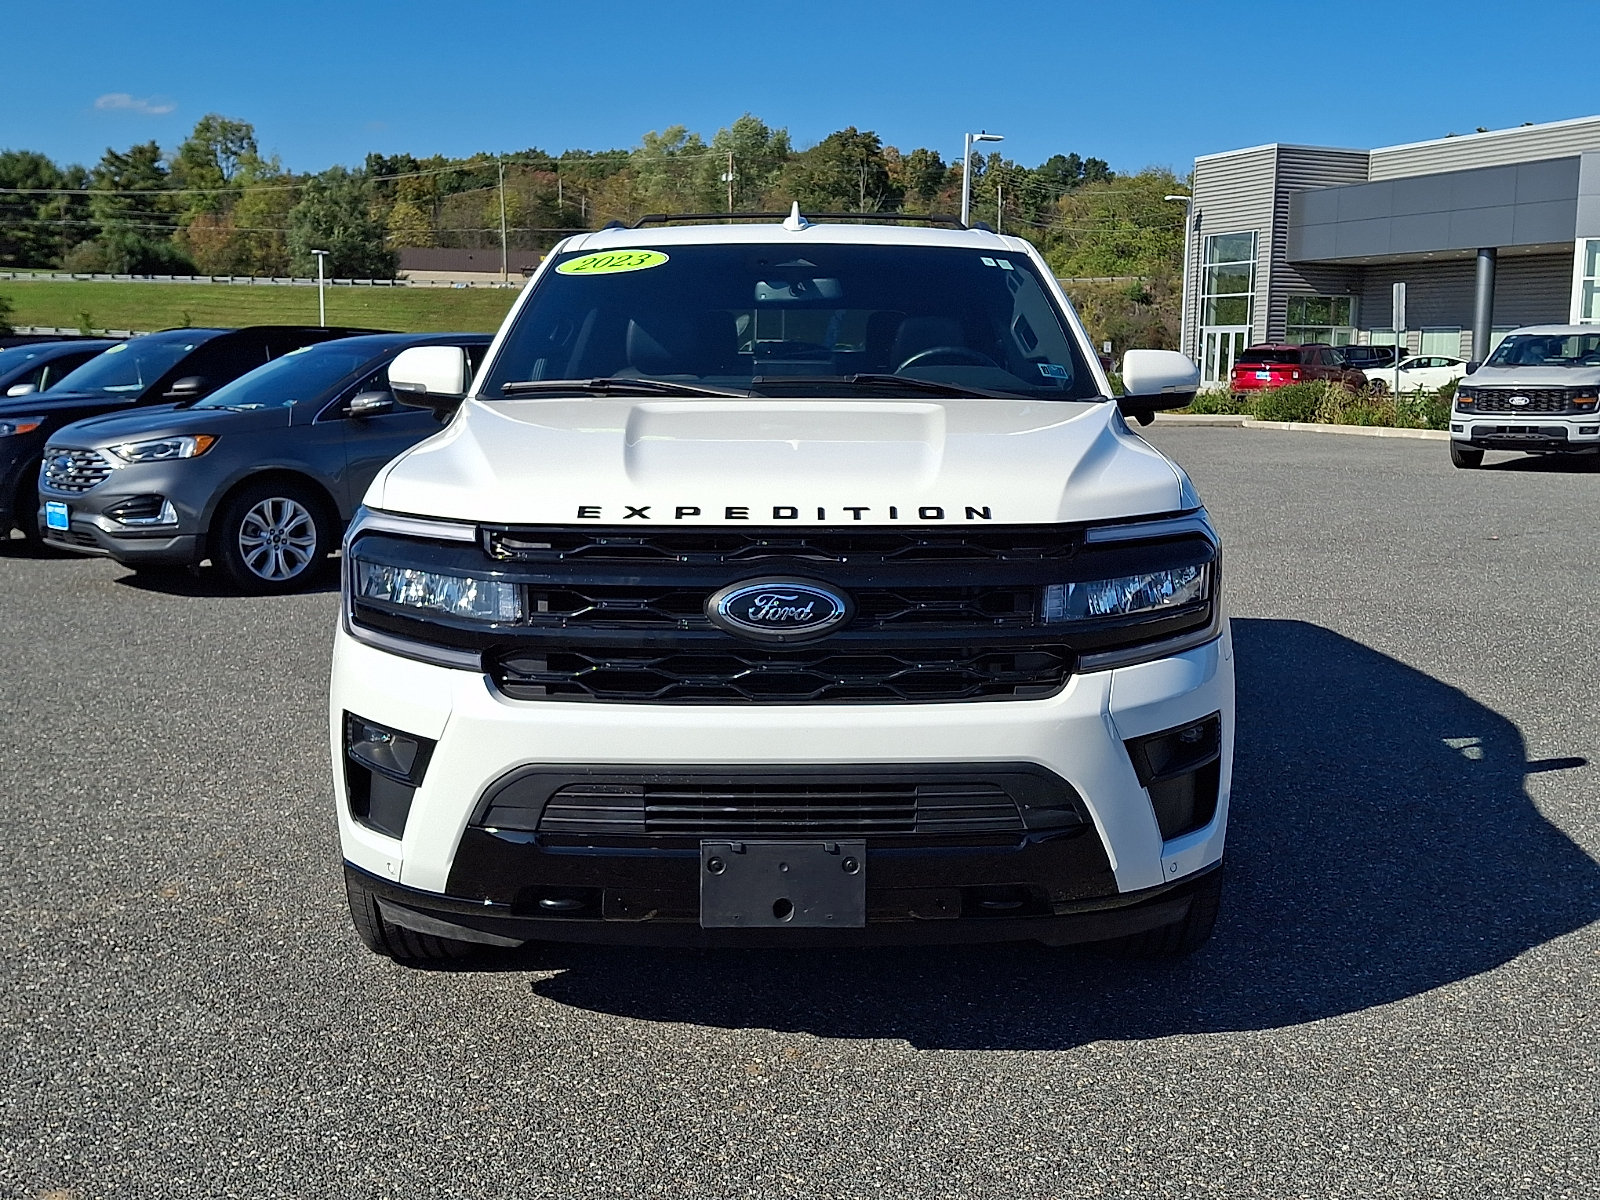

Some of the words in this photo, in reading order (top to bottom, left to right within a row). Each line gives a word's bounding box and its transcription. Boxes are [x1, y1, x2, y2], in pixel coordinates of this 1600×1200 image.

[573, 253, 652, 271] 2023
[576, 505, 992, 520] EXPEDITION
[748, 593, 815, 621] Ford
